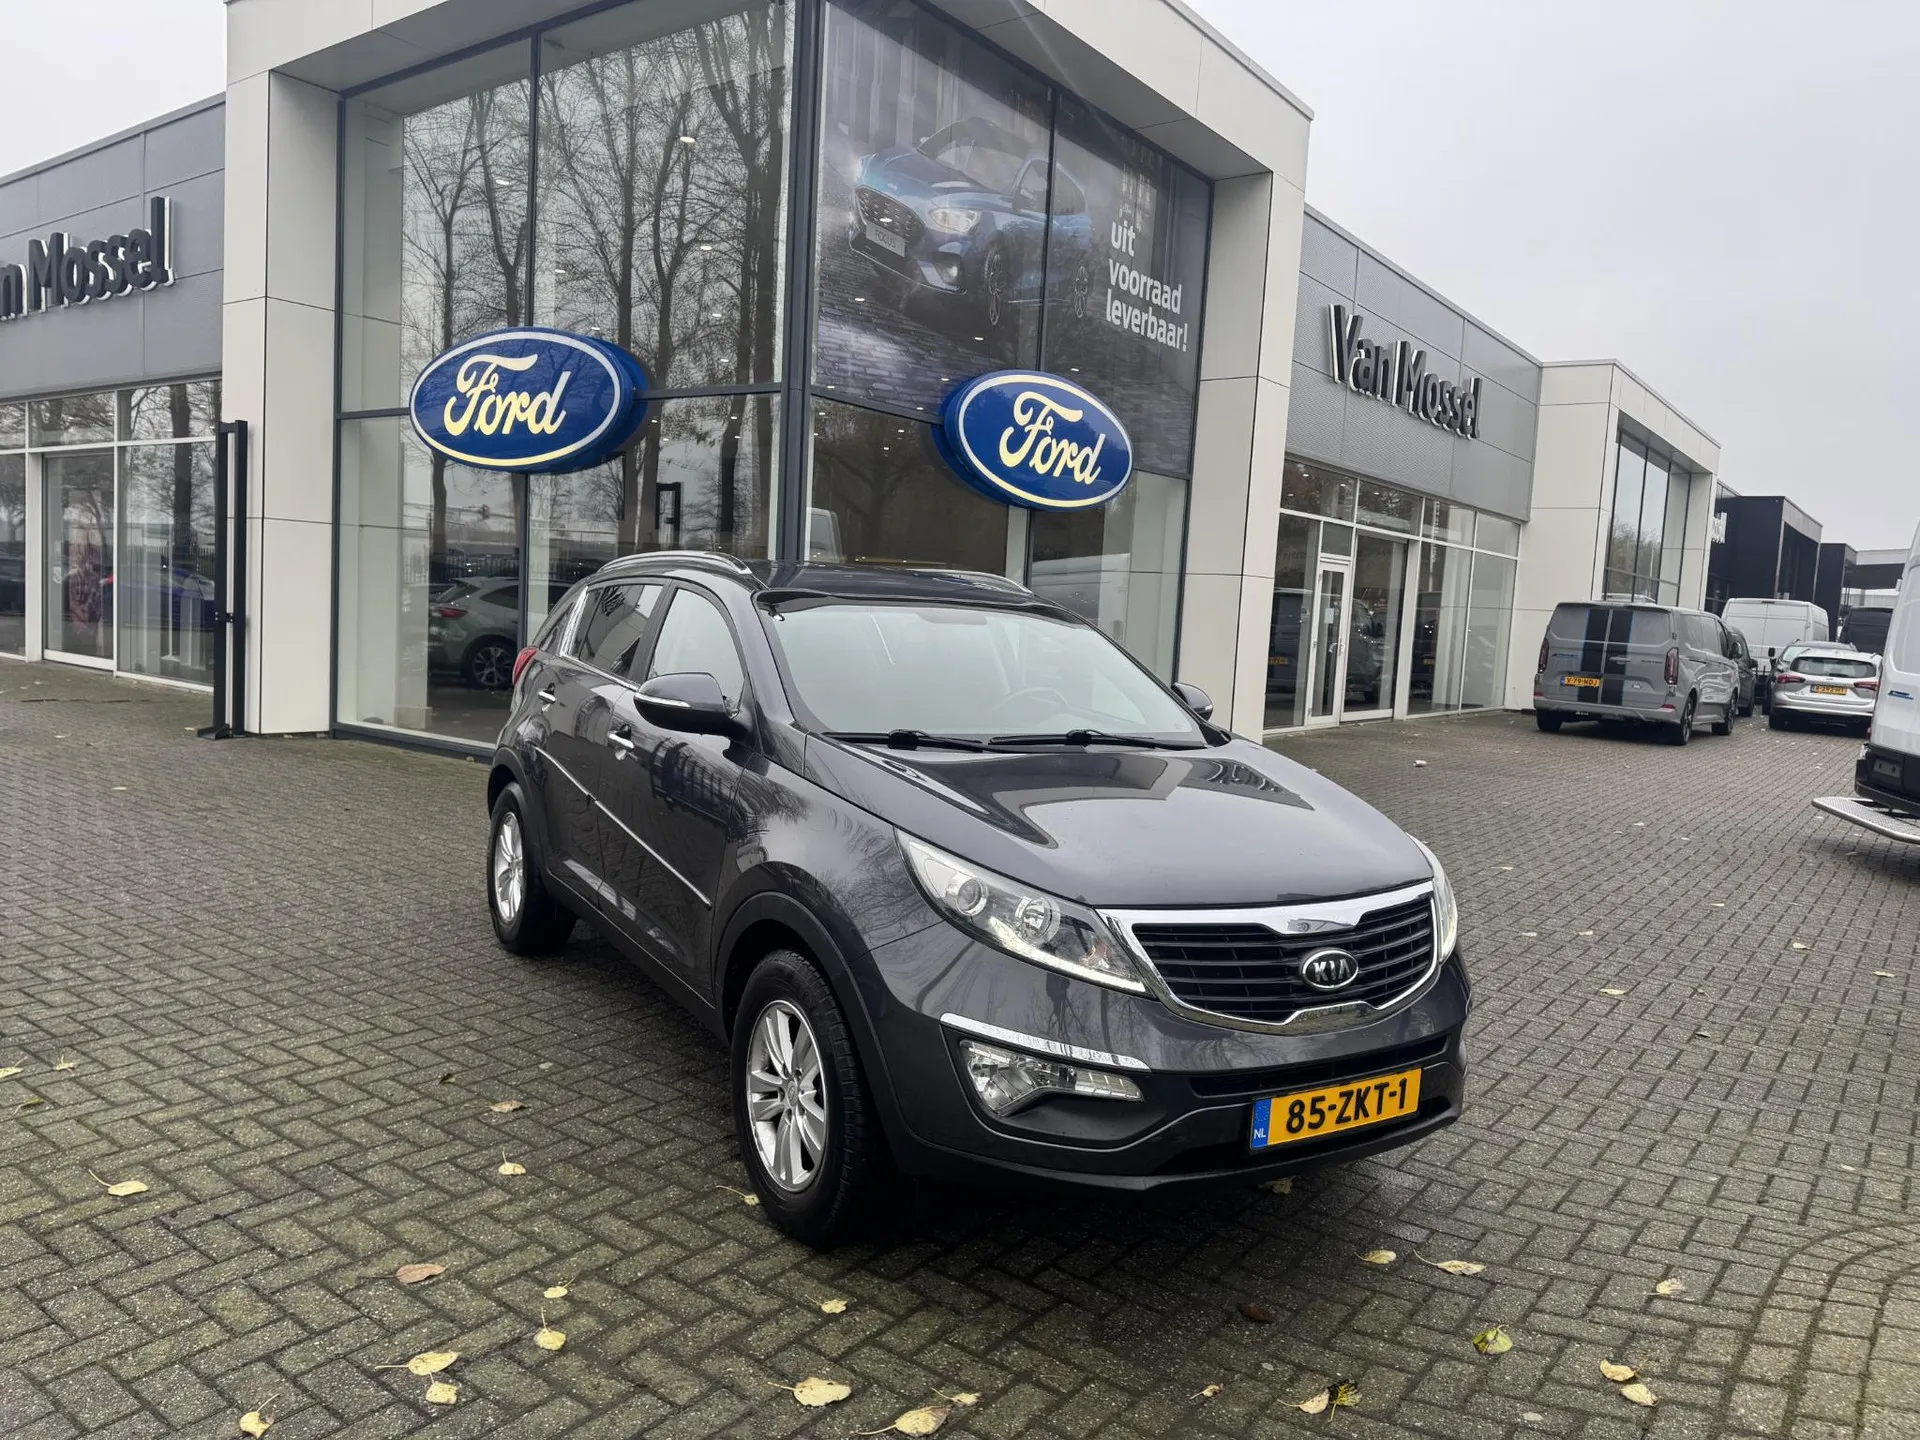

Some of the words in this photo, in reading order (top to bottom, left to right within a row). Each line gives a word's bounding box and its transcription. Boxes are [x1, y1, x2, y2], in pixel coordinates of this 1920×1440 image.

[28, 195, 172, 311] Mossel
[1111, 219, 1136, 257] uit
[1108, 258, 1182, 315] voorraad
[1105, 288, 1188, 352] leverbaar!
[443, 353, 572, 436] Ford
[1331, 304, 1394, 401] Van
[1396, 340, 1483, 439] Mossel
[999, 390, 1106, 485] Ford
[1313, 958, 1352, 982] KIA
[1253, 1127, 1267, 1140] NL
[1285, 1077, 1408, 1135] 85-ZKT-1
